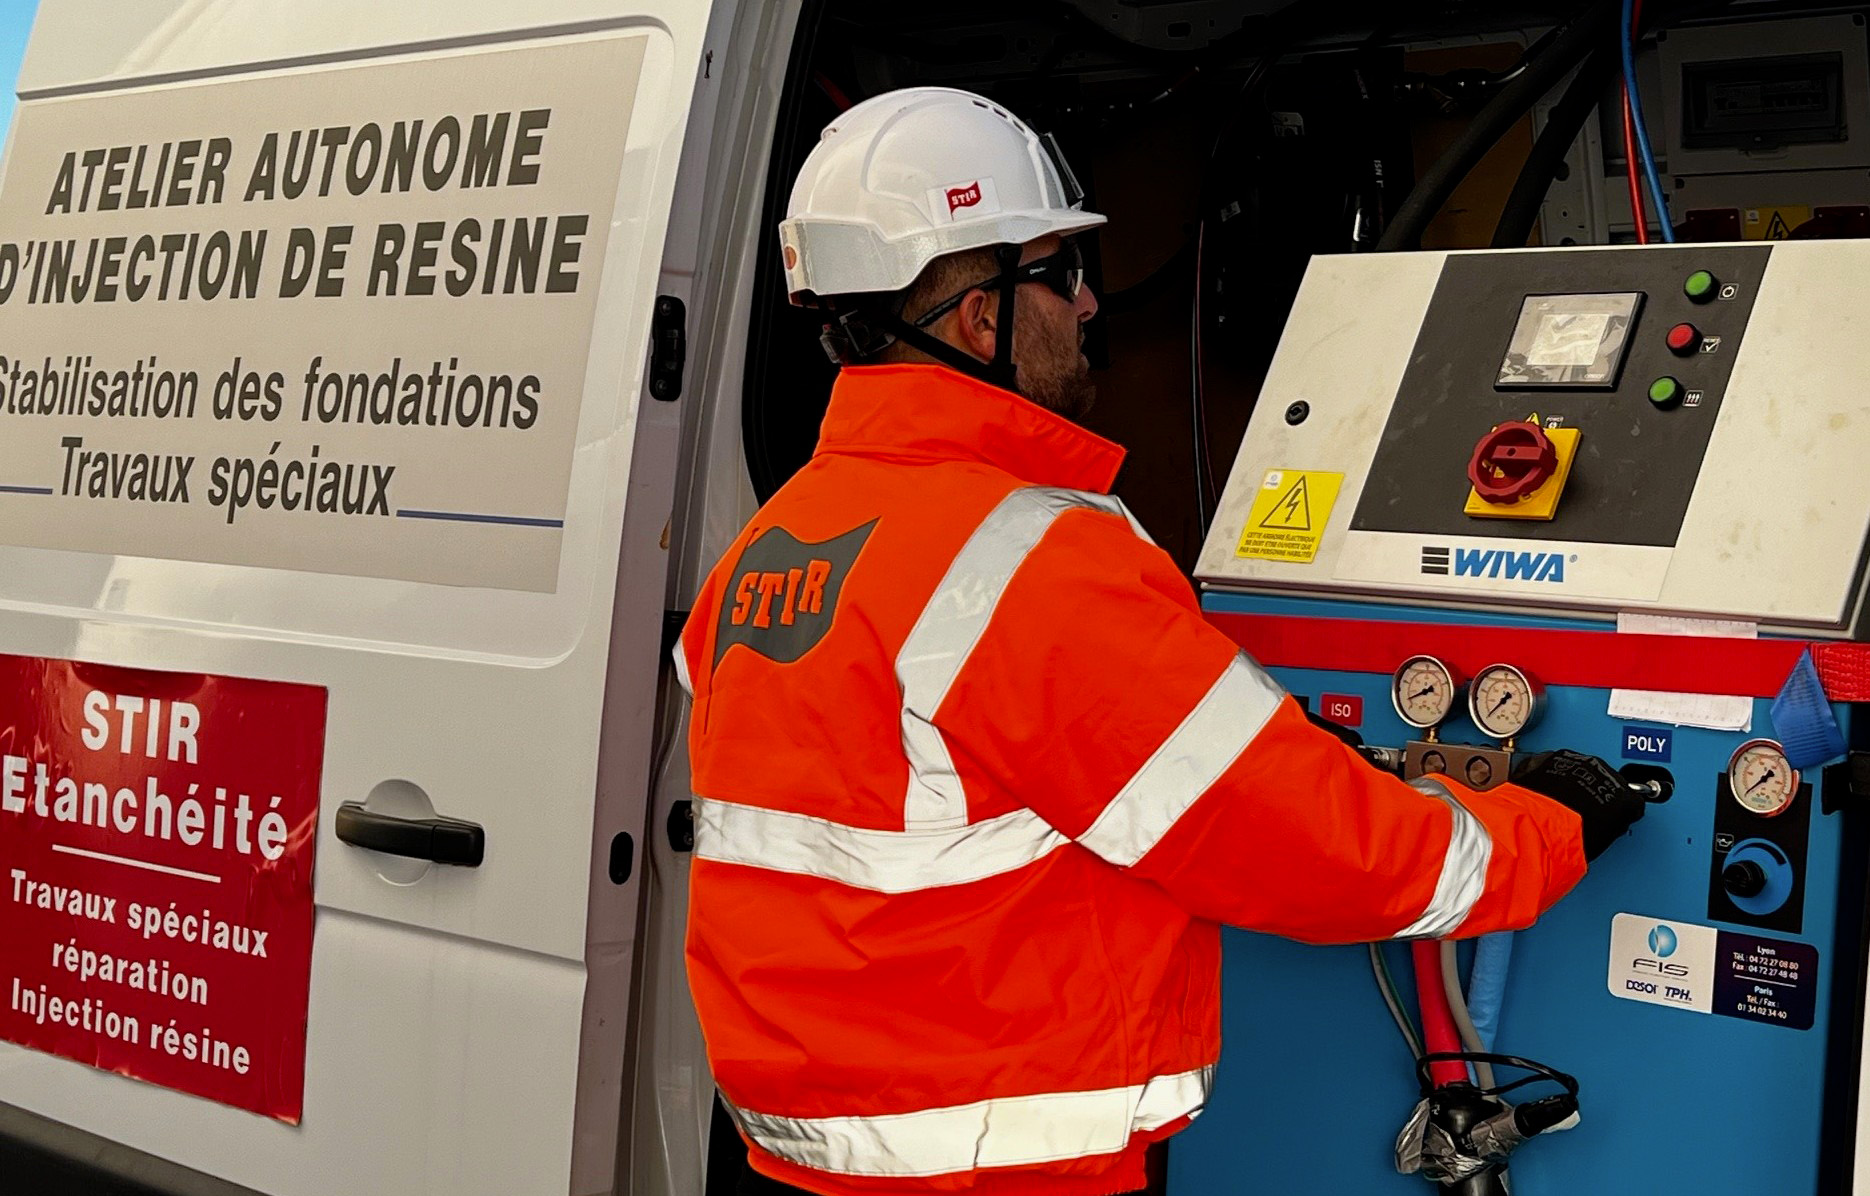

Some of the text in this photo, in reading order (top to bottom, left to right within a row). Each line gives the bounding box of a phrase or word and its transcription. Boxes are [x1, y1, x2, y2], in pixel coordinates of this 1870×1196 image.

[45, 108, 552, 215] ATELIER AUTONOME
[950, 188, 978, 206] STIR
[278, 225, 355, 299] DE
[365, 214, 590, 298] RESINE
[212, 356, 285, 422] des
[301, 355, 541, 430] fondations
[60, 436, 397, 525] Travaux spéciaux
[1454, 548, 1564, 583] WIWA
[731, 558, 832, 629] STIR
[81, 690, 201, 765] STIR
[1330, 702, 1352, 718] ISO
[1627, 734, 1667, 753] POLY
[2, 754, 289, 861] Etanchéité
[10, 868, 269, 959] Travaux spéciaux
[1632, 958, 1690, 977] FIS
[1748, 955, 1758, 963] 04
[1758, 957, 1768, 965] 72
[1769, 958, 1778, 967] 27
[1756, 945, 1776, 956] Lyon
[52, 938, 208, 1008] réparation
[1732, 961, 1744, 970] Fax
[1748, 964, 1758, 973] 04
[1758, 966, 1768, 975] 72
[1768, 968, 1778, 977] 27
[1753, 985, 1773, 996] Paris
[1763, 998, 1776, 1007] Fax
[12, 977, 251, 1075] Injection résine
[1747, 1005, 1757, 1013] 34
[1767, 1009, 1777, 1018] 34
